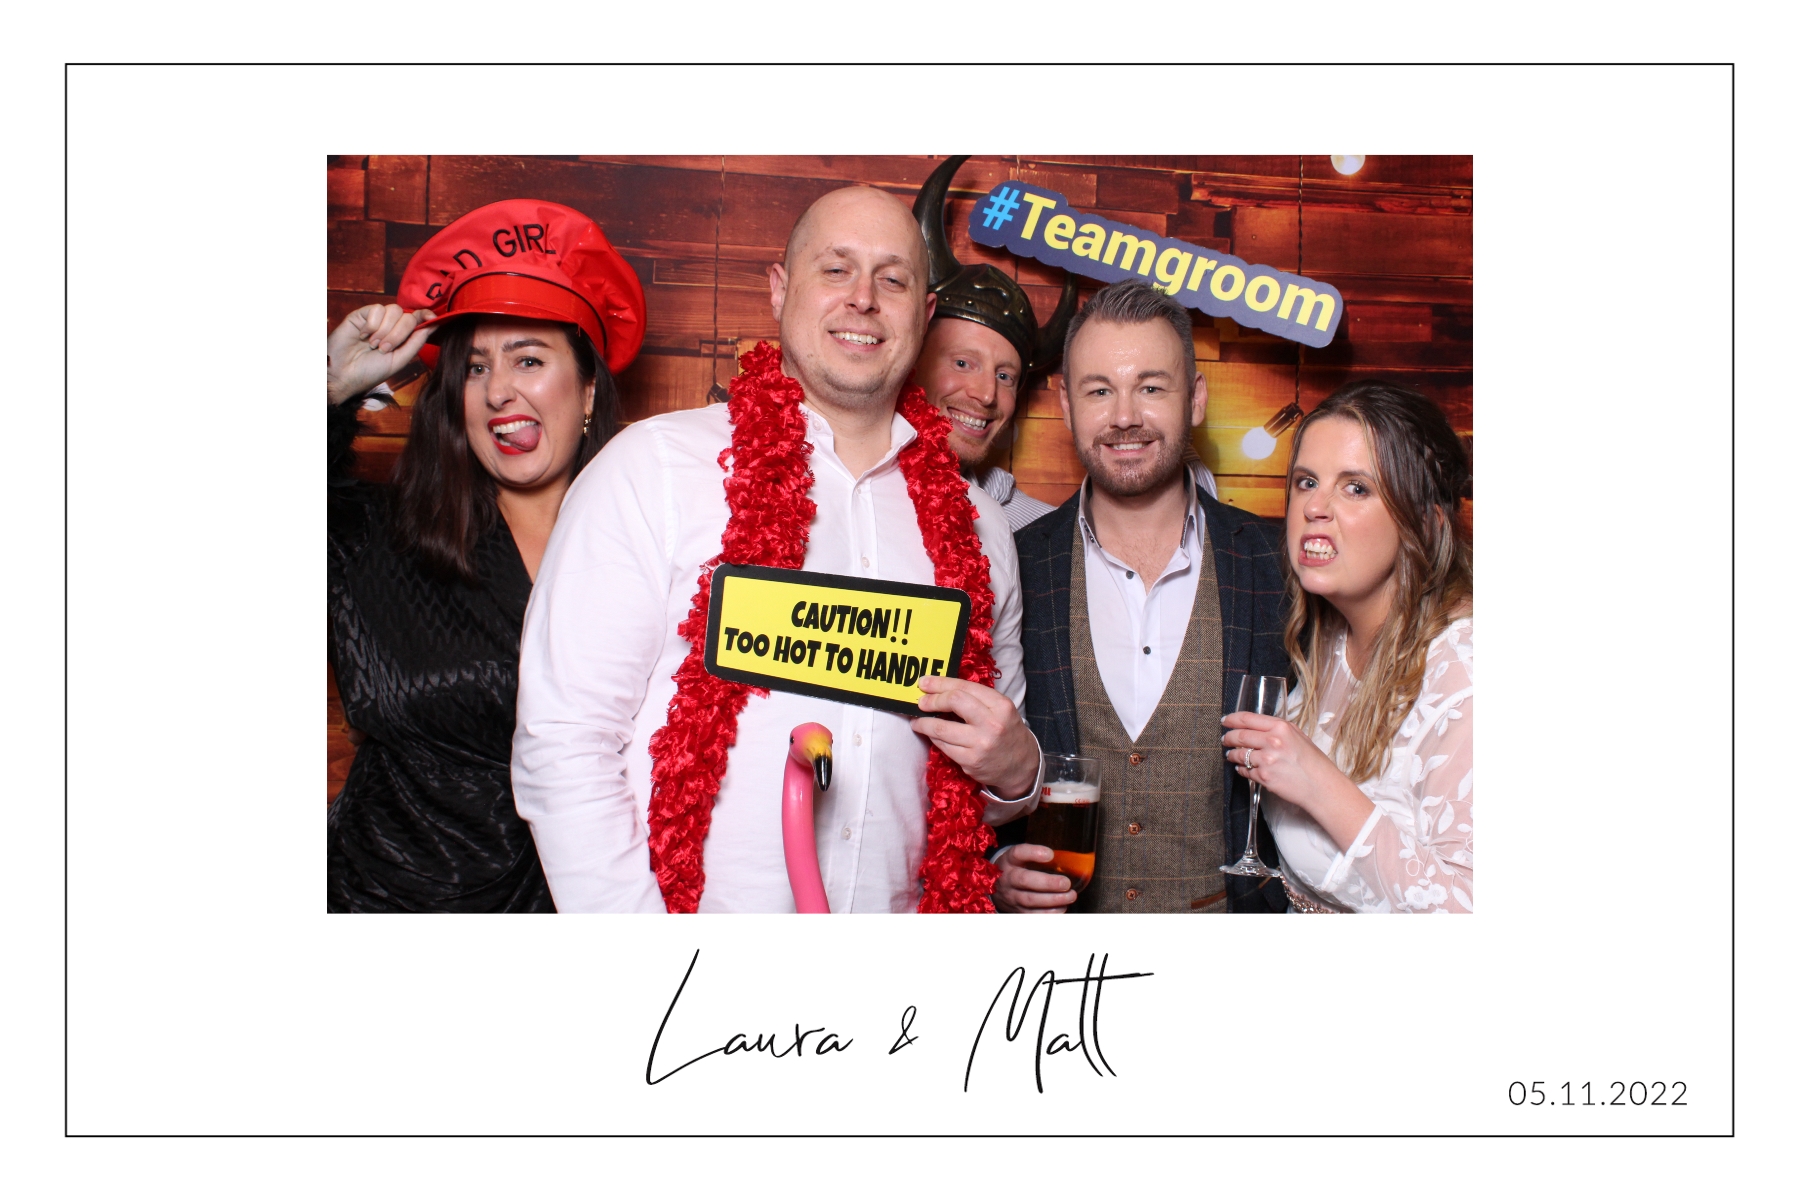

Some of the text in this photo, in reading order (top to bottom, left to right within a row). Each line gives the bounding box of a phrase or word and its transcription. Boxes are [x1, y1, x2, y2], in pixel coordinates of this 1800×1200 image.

[492, 223, 557, 258] GIRL
[982, 186, 1336, 332] #Teamgroom
[791, 600, 913, 646] CAUTION!!
[724, 626, 770, 657] TOO
[773, 635, 822, 668] HOT
[825, 642, 854, 674] TO
